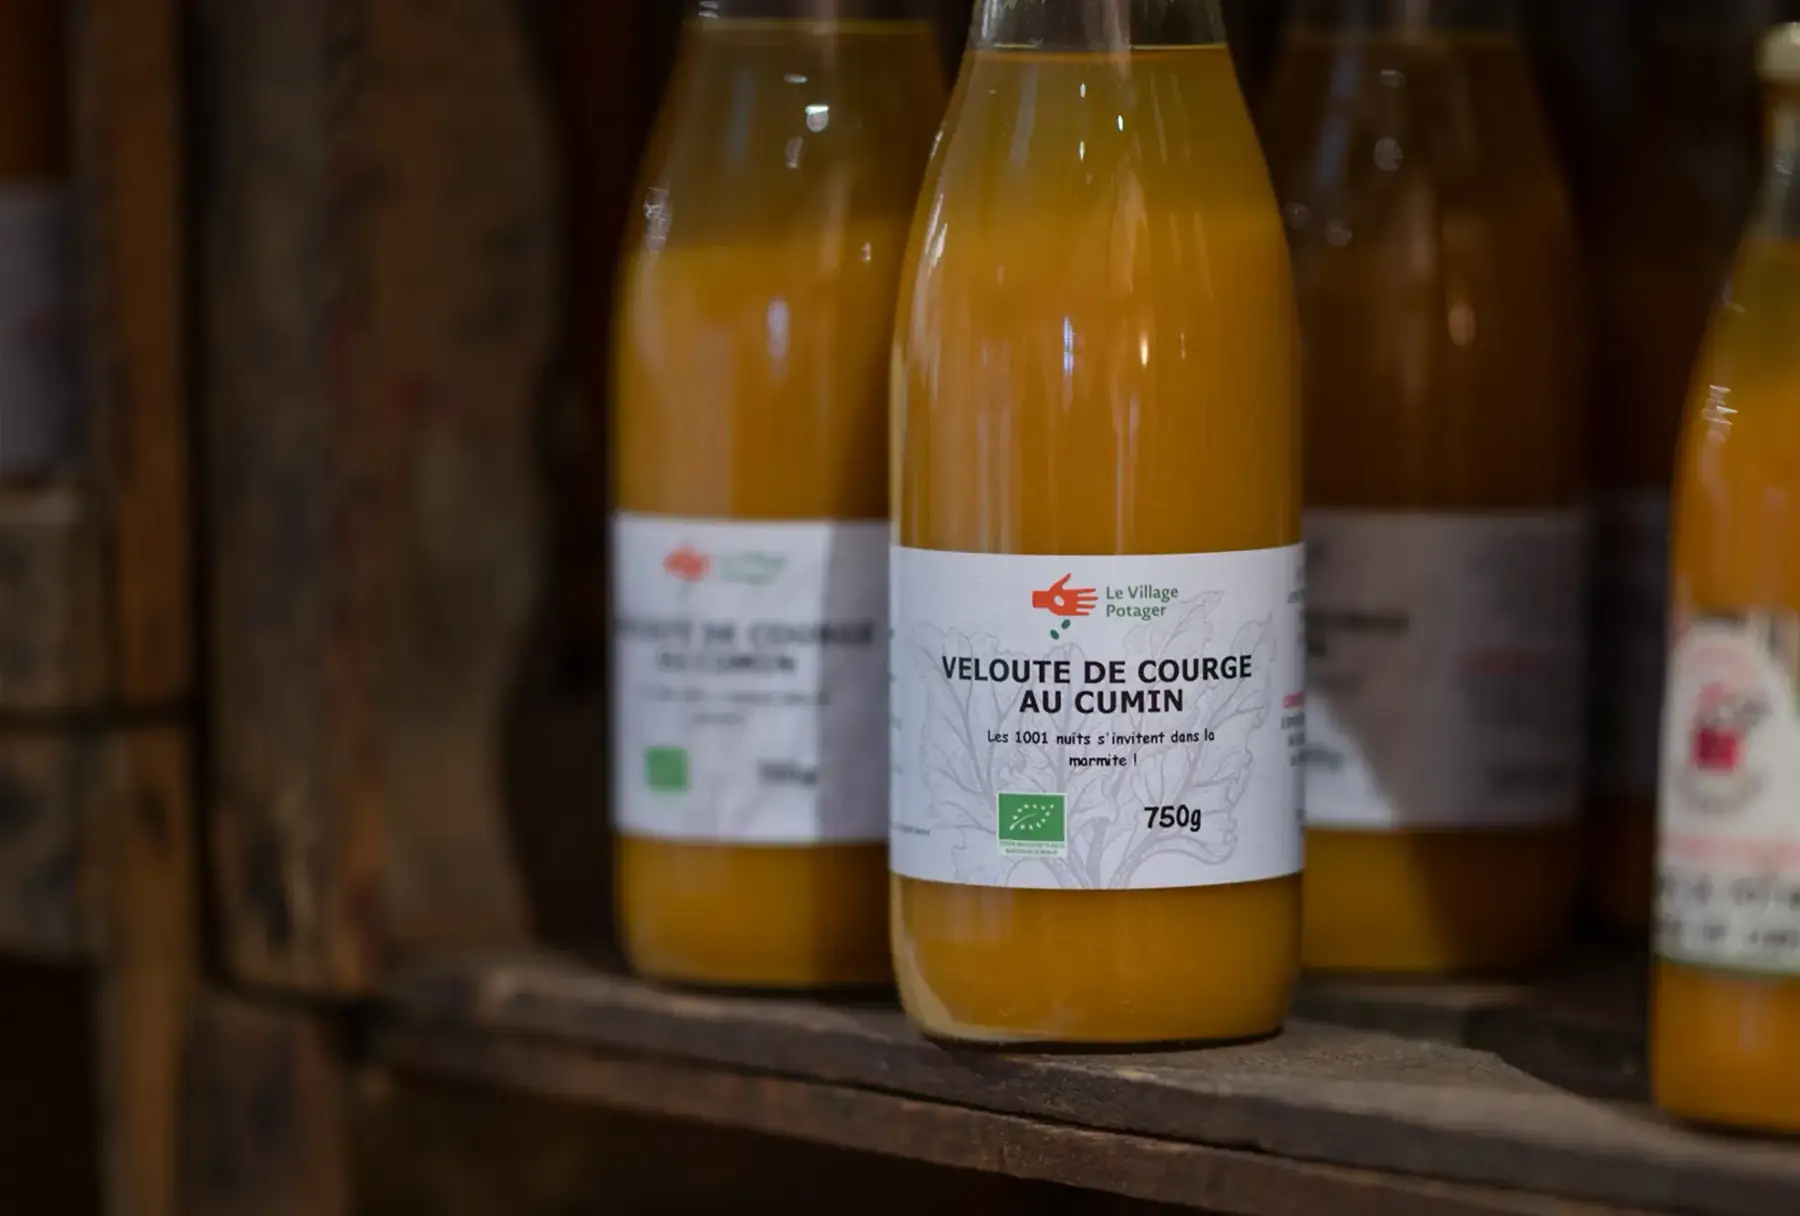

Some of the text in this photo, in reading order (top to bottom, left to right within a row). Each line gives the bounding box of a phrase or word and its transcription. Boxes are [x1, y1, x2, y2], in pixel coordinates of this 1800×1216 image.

[1106, 585, 1179, 602] Le Village
[1106, 604, 1167, 621] Potager
[942, 655, 1252, 684] VELOUTE DE COURGE
[1019, 689, 1183, 714] AU CUMIN
[987, 728, 1215, 745] Les 1001 nuits s'invitent dans la
[1069, 754, 1127, 767] marmite
[1143, 805, 1202, 832] 750g
